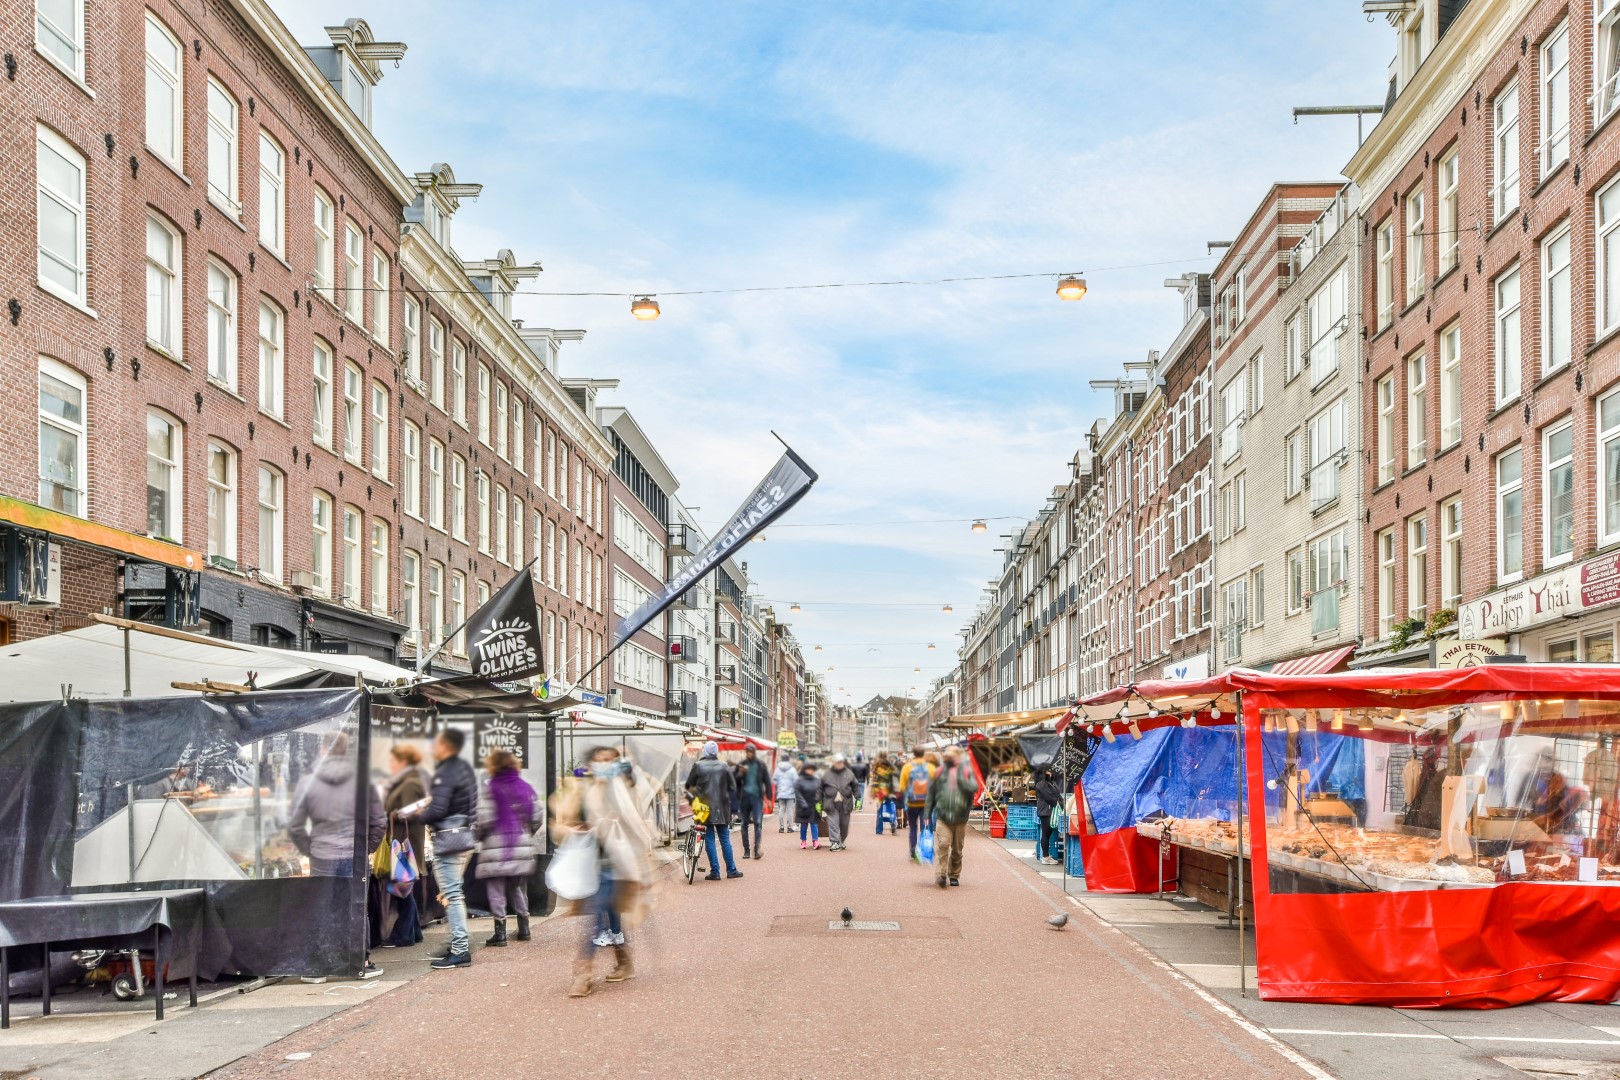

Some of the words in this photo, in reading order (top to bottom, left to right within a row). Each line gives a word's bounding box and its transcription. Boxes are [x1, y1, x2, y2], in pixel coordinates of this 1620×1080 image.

[1503, 592, 1523, 604] EETHUIS
[474, 634, 527, 661] TWINS
[1442, 644, 1462, 660] THAI
[480, 646, 537, 676] OLIVE'S
[515, 664, 528, 674] weet
[528, 661, 538, 669] het
[479, 731, 517, 746] TWINS
